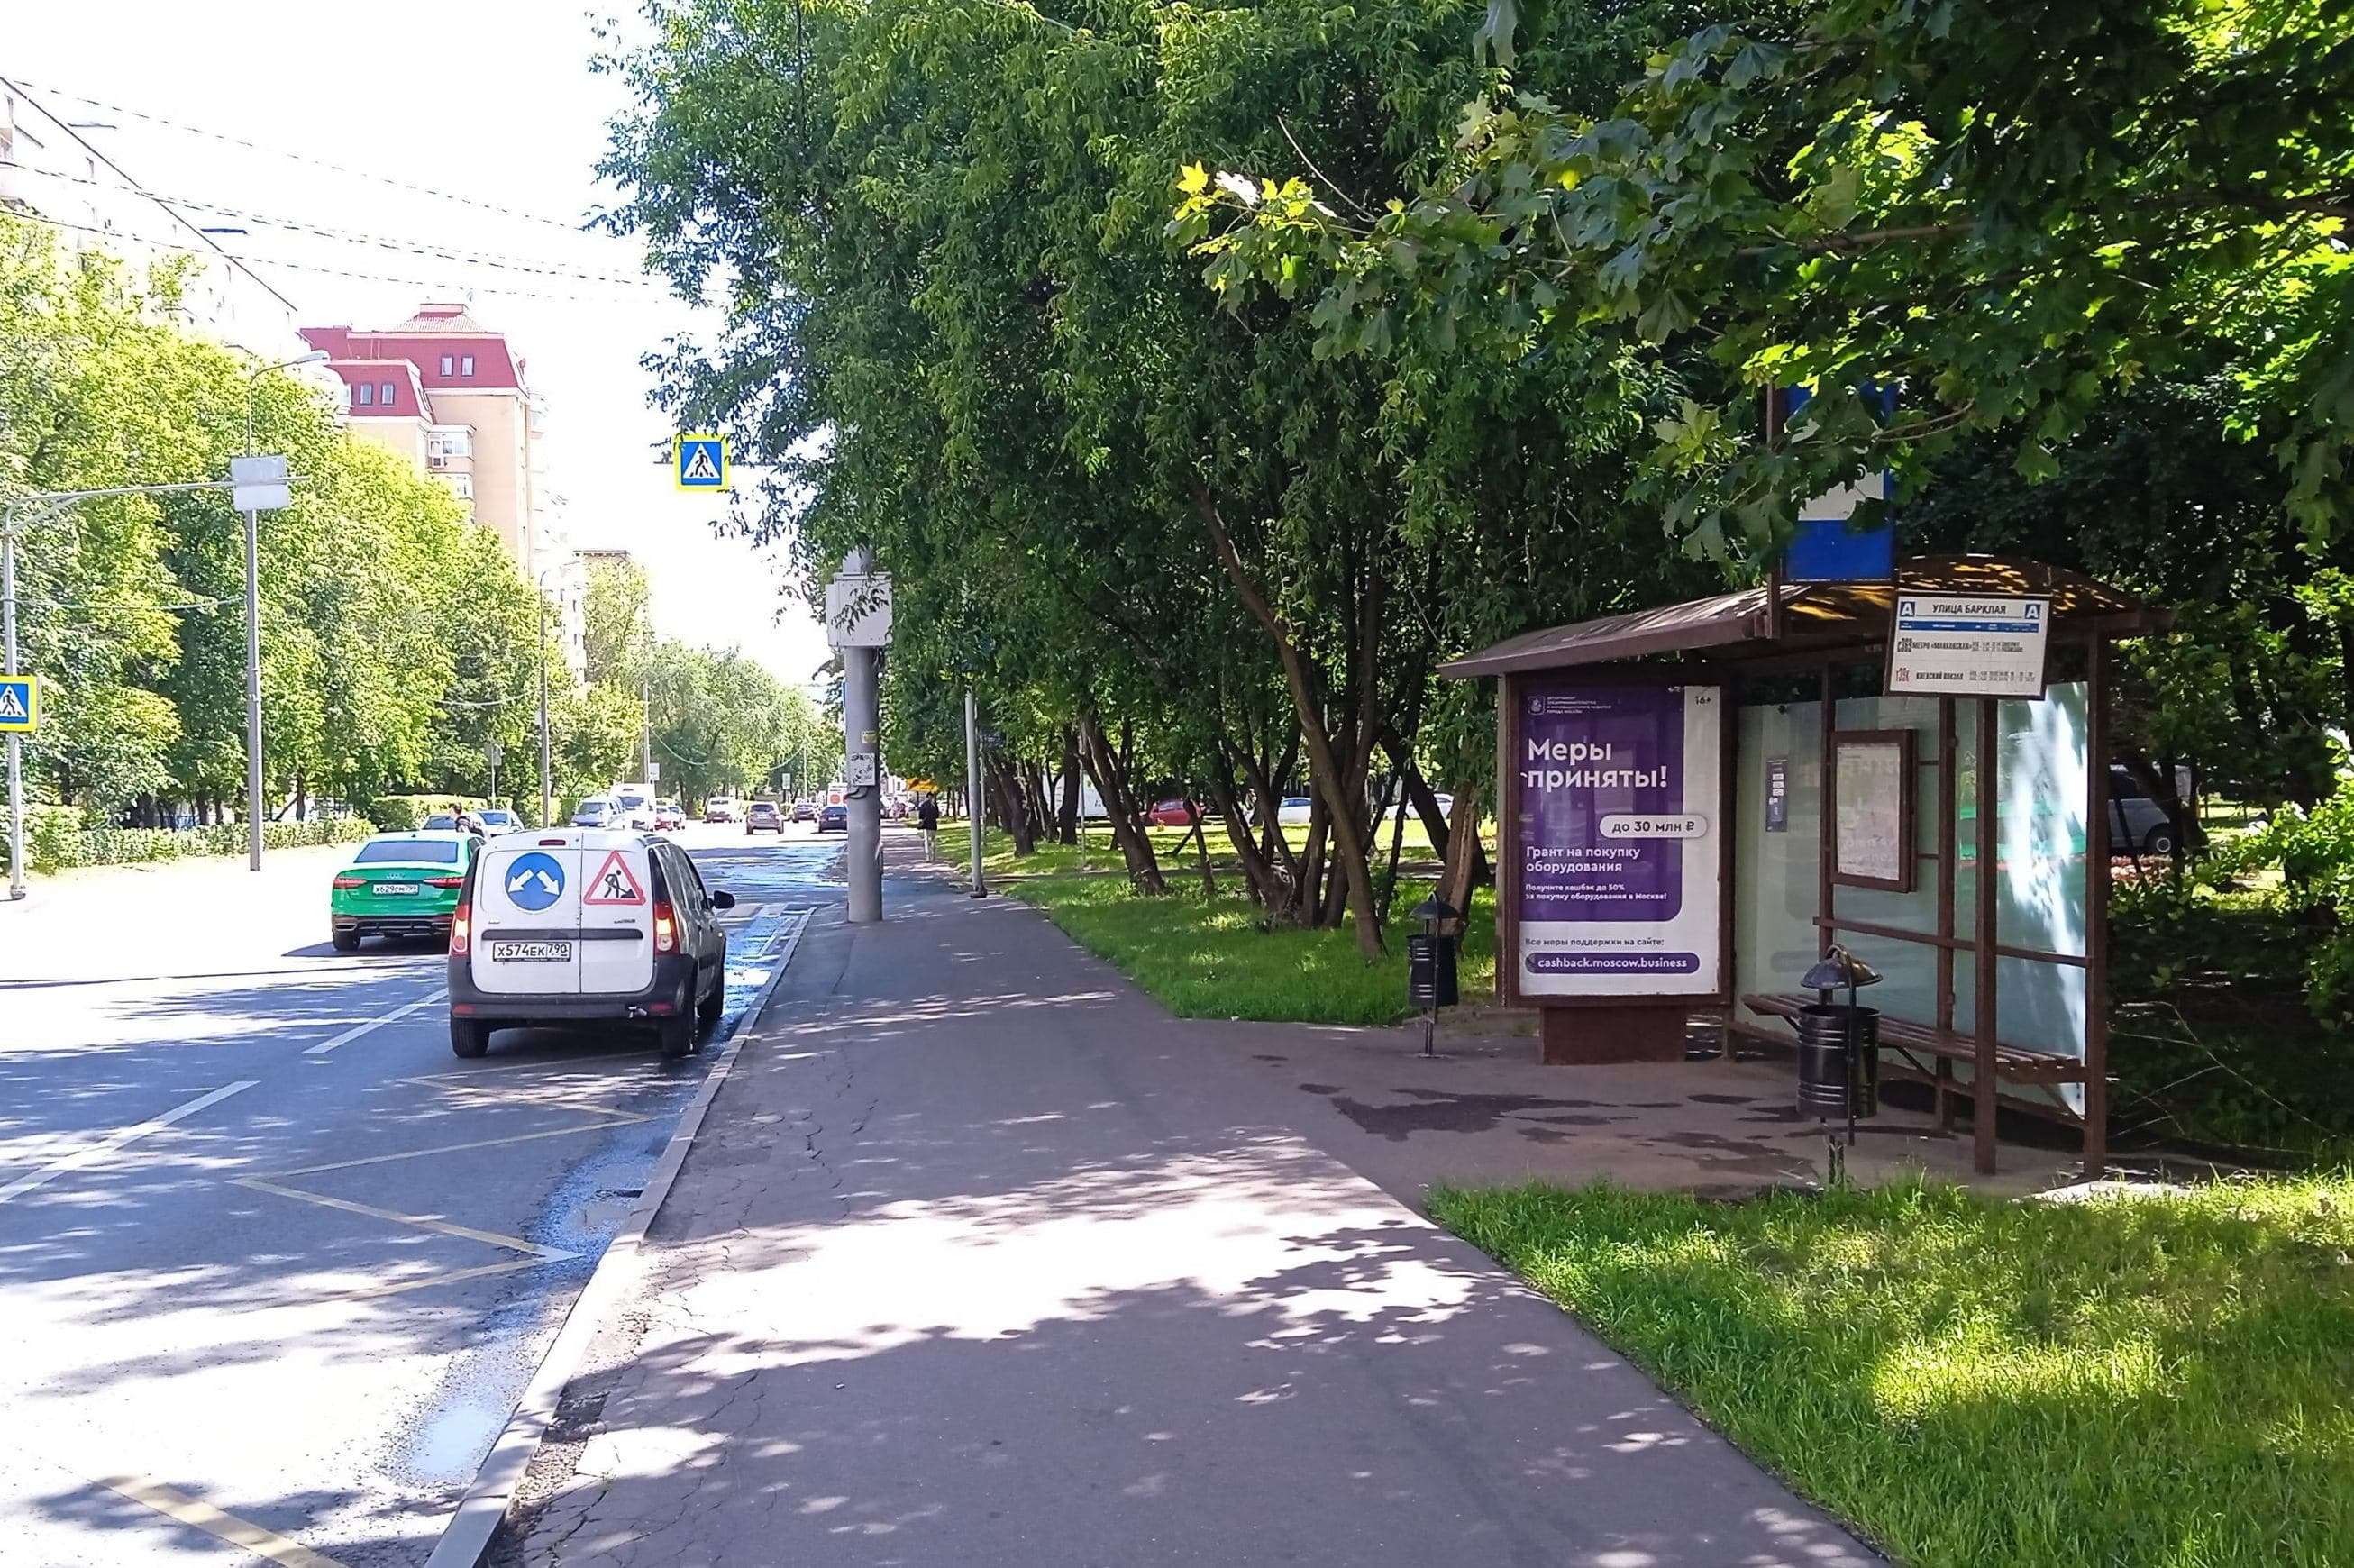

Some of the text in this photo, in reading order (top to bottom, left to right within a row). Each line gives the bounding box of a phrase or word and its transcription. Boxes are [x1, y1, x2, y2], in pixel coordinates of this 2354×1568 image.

[1932, 604, 2006, 615] УЛИЦА БАРКЛАЯ
[1695, 696, 1711, 705] 16+
[1528, 738, 1611, 766] Меры
[1528, 766, 1667, 793] приняты!
[1612, 822, 1630, 834] до
[1634, 821, 1650, 832] 30
[1656, 824, 1682, 832] млн
[1526, 846, 1641, 861] Грант на покупку
[1526, 861, 1622, 875] оборудования
[1525, 884, 1564, 892] Получите
[1571, 892, 1628, 901] оборудования
[1543, 939, 1568, 947] меры
[1571, 939, 1622, 947] поддержки
[1637, 937, 1665, 945] сайте:
[1537, 956, 1688, 968] cashback.moscow.business
